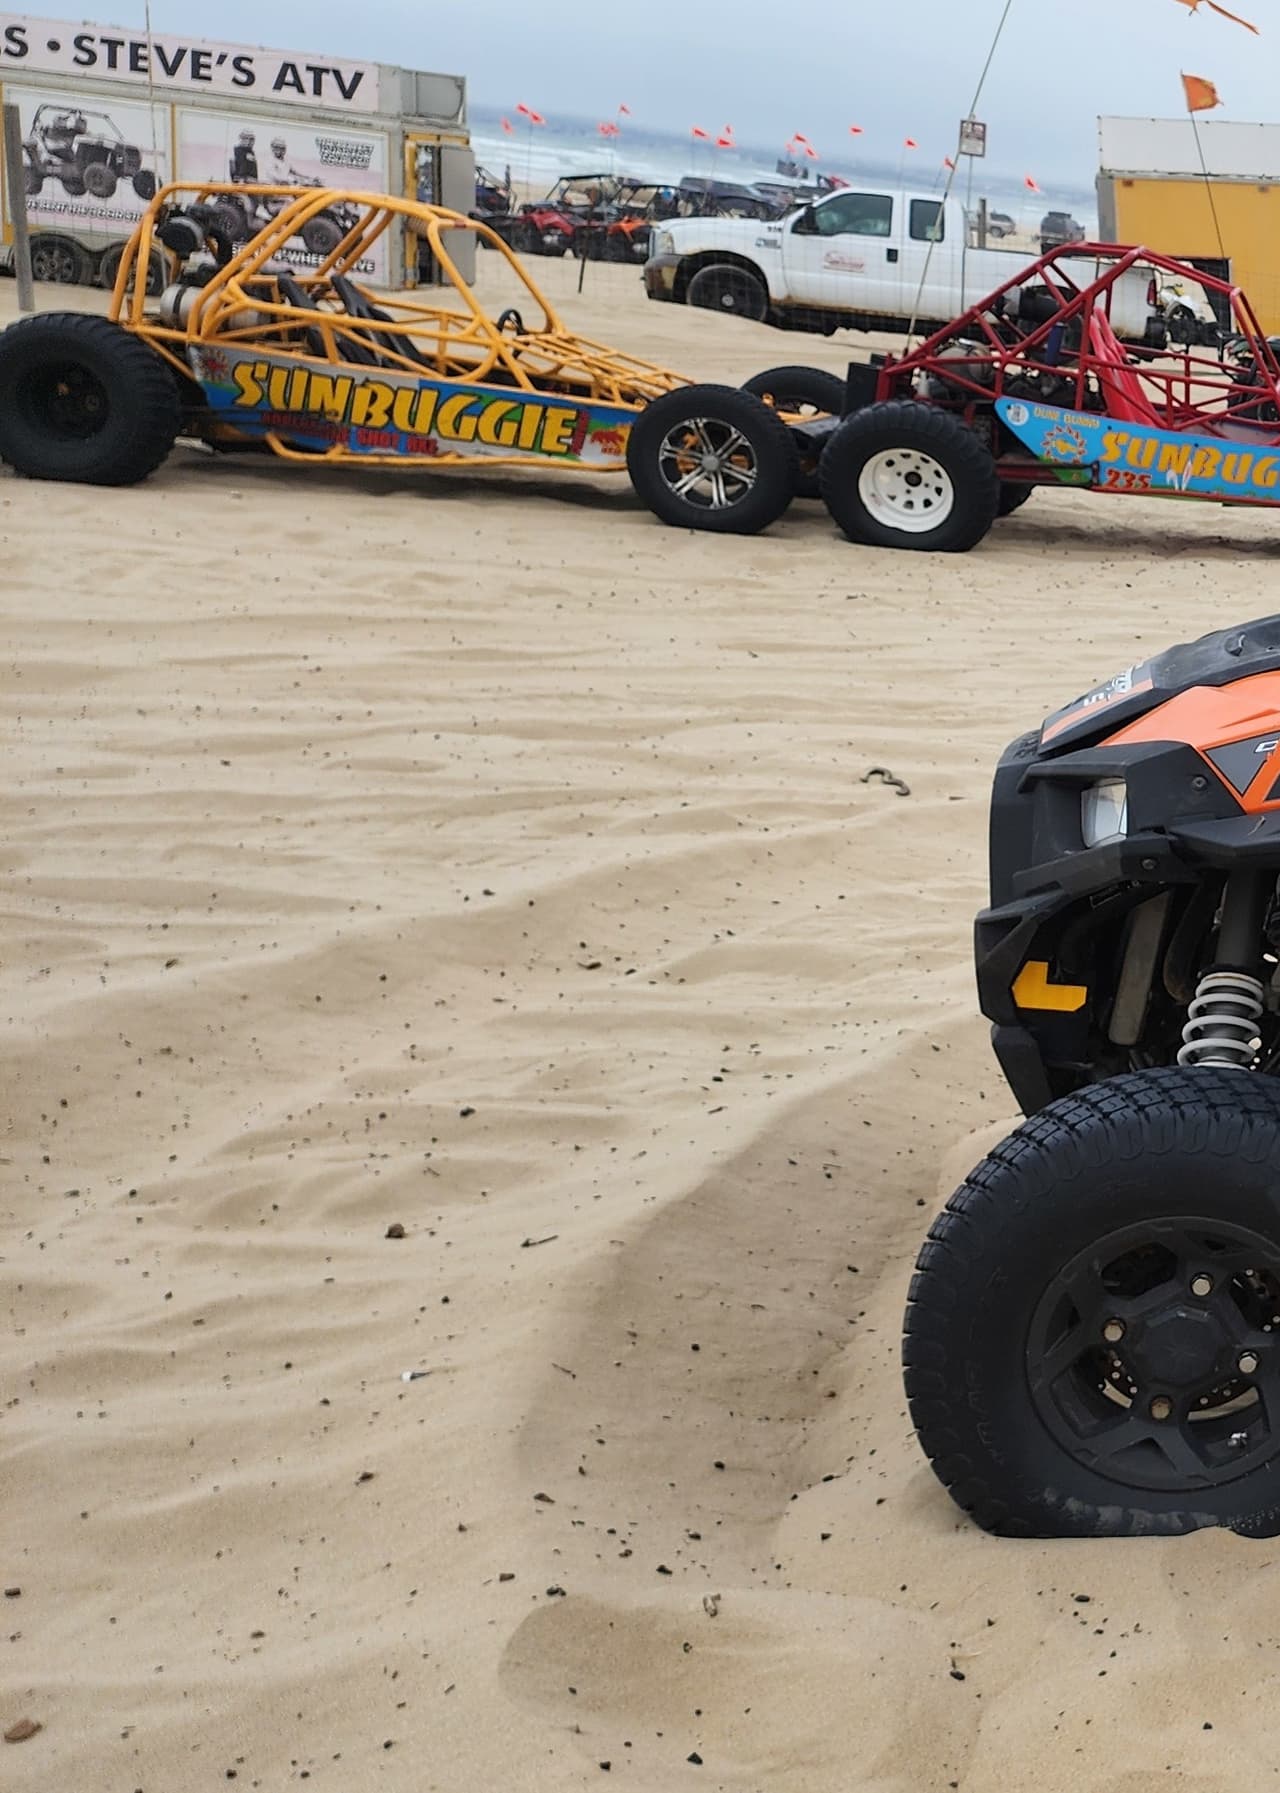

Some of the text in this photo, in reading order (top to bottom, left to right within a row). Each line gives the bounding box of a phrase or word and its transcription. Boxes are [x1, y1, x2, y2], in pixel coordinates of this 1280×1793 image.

[73, 34, 256, 87] STEVE'S
[272, 62, 364, 100] ATV
[335, 256, 375, 272] DIVE
[232, 360, 579, 454] SUNBUGGIE
[1105, 468, 1151, 489] 235
